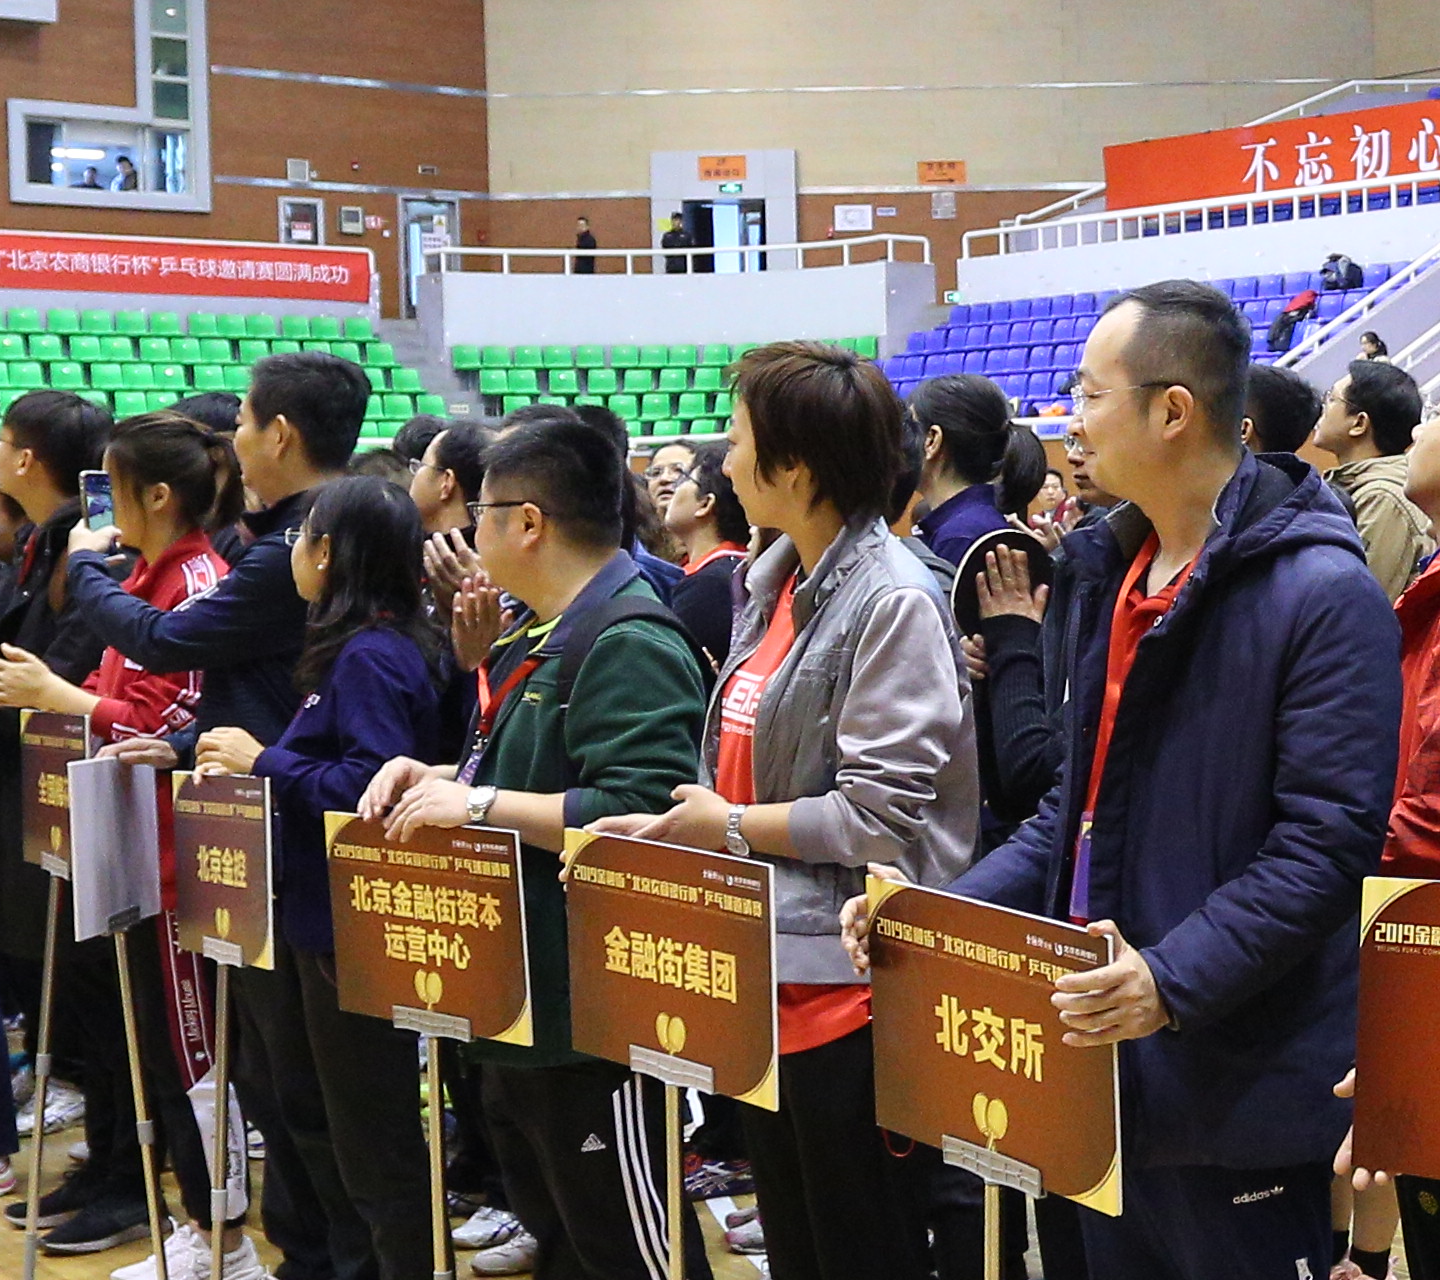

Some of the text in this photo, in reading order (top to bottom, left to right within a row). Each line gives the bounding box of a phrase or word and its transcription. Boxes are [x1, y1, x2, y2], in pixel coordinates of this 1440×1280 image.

[349, 874, 502, 931] 北京金融街资本
[384, 921, 472, 970] 运营中心
[604, 925, 738, 1004] 金融街集团
[935, 993, 1046, 1082] 北交所
